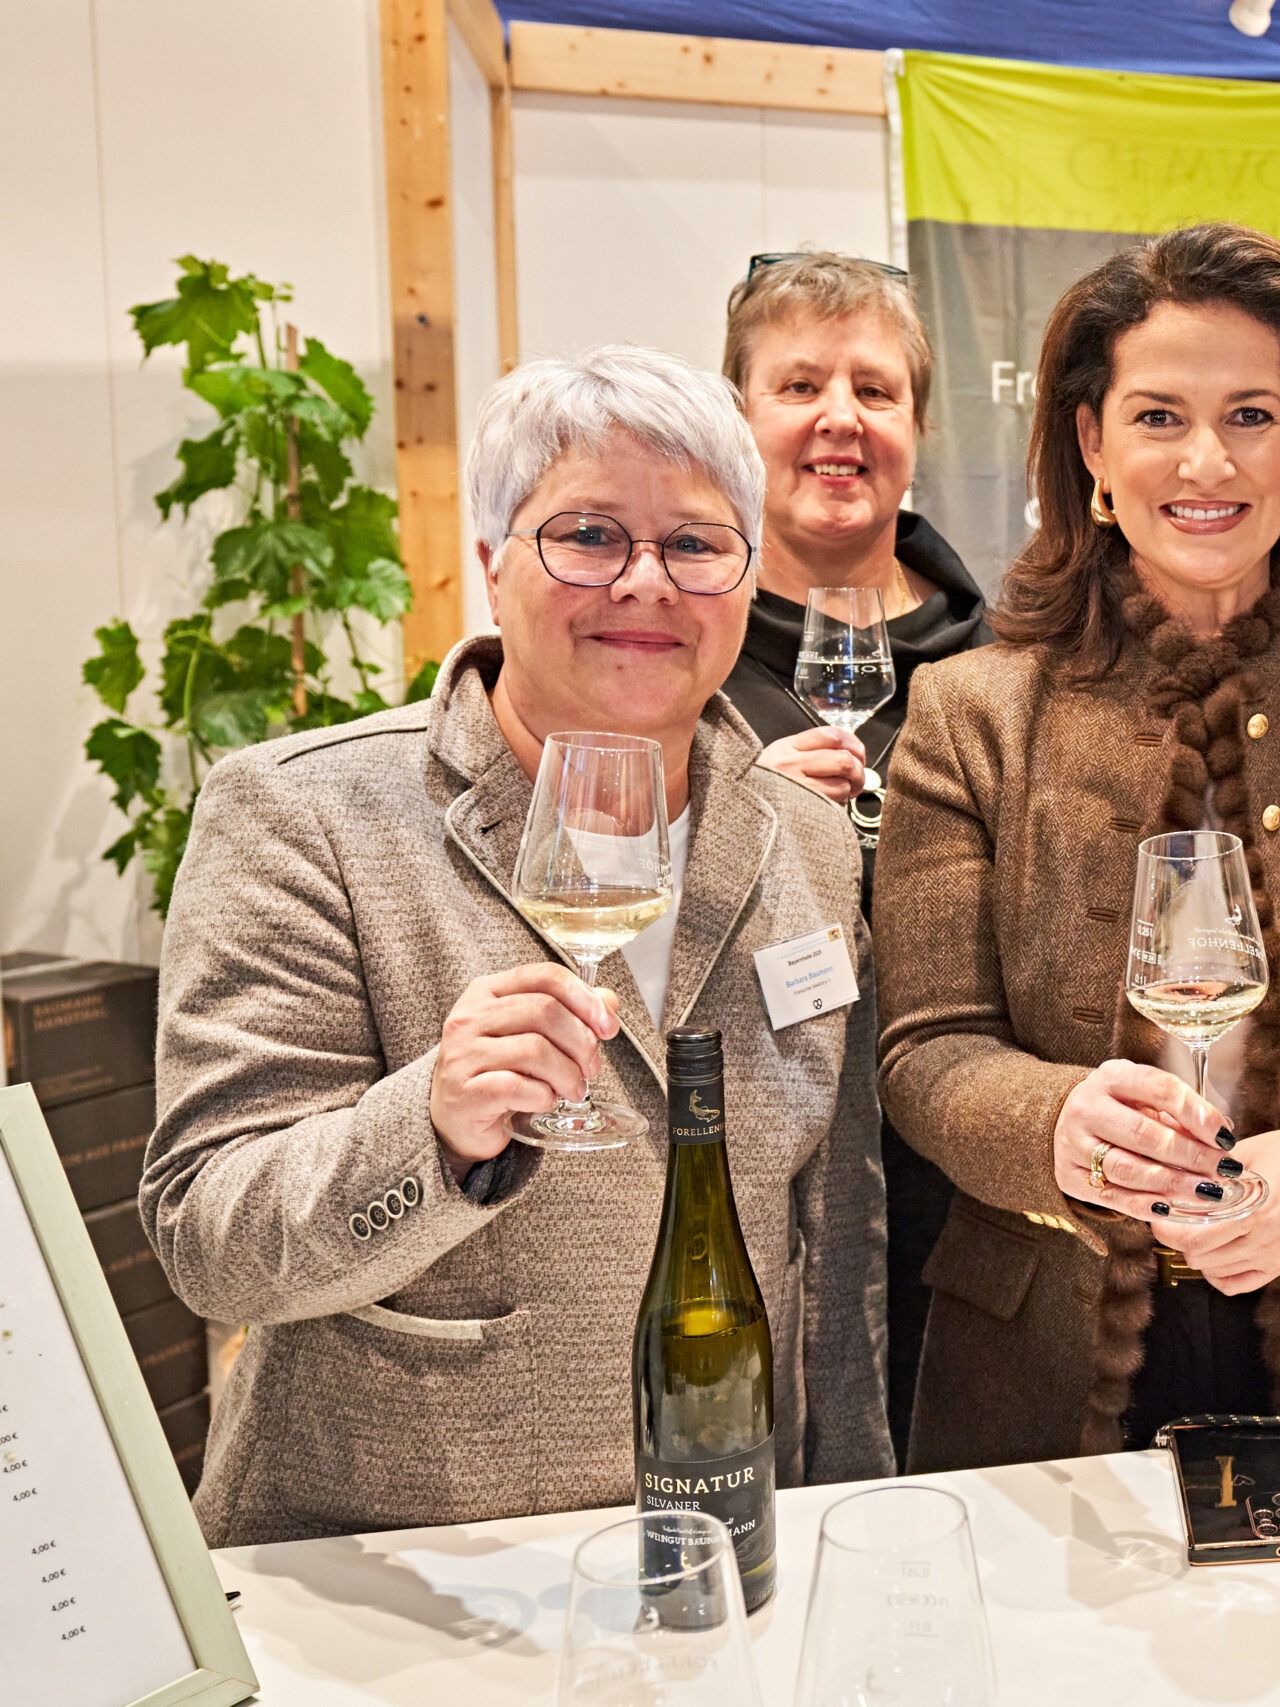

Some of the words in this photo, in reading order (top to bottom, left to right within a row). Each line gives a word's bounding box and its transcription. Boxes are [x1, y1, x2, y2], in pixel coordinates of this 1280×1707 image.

[3, 1462, 21, 1474] 4,00
[645, 1466, 756, 1495] SIGNATUR
[13, 1490, 31, 1502] 4,00
[646, 1495, 701, 1511] SILVANER
[646, 1530, 688, 1546] WEINGUT
[31, 1543, 50, 1555] 4,00
[41, 1571, 60, 1584] 4,00
[51, 1599, 70, 1612] 4,00
[61, 1628, 80, 1641] 4,00
